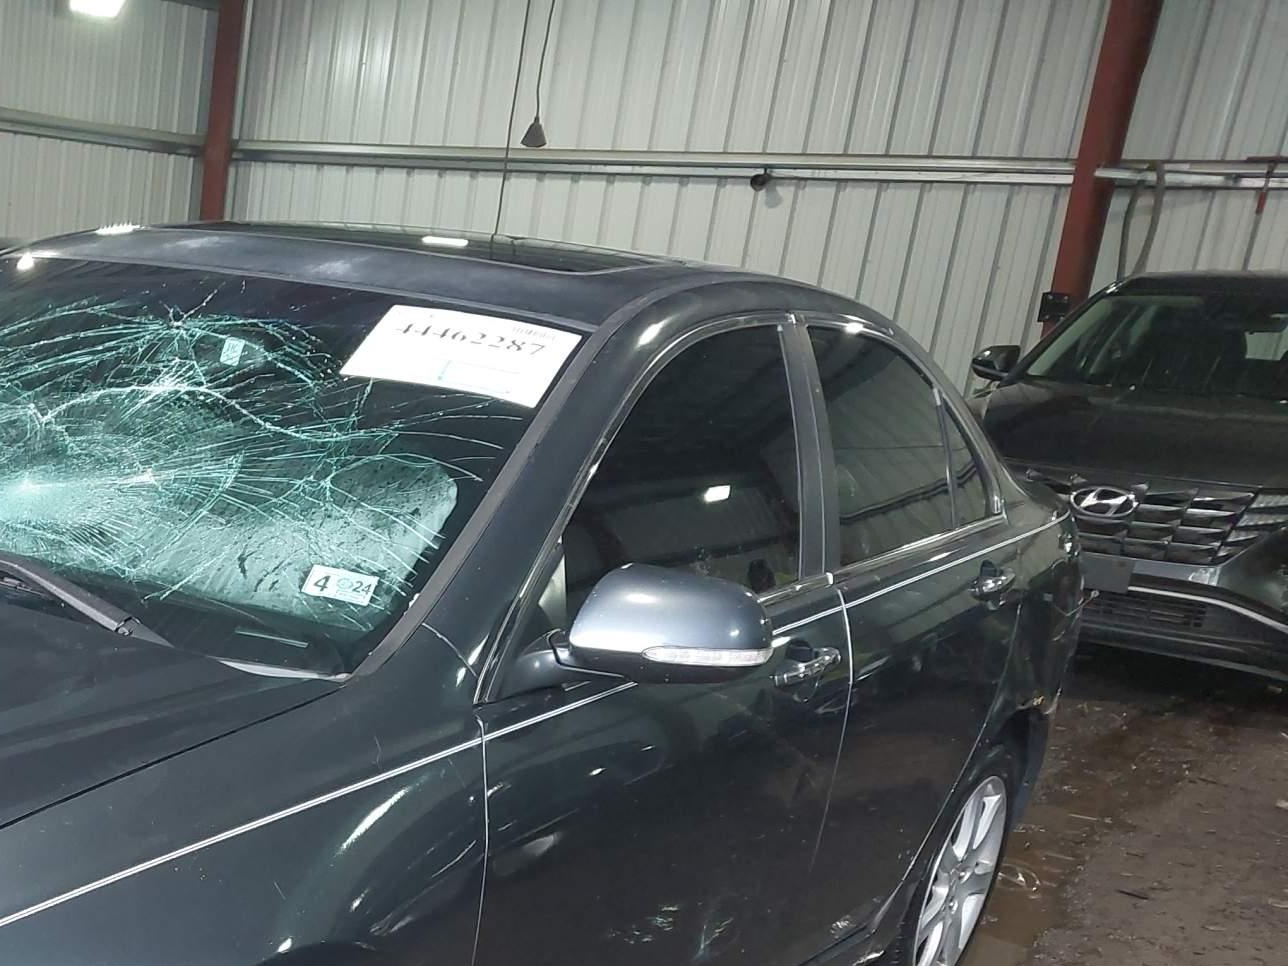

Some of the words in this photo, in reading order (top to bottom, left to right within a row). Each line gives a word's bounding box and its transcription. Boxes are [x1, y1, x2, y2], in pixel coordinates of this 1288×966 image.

[395, 322, 546, 356] 44462287
[313, 575, 331, 592] 4
[352, 580, 372, 595] 24
